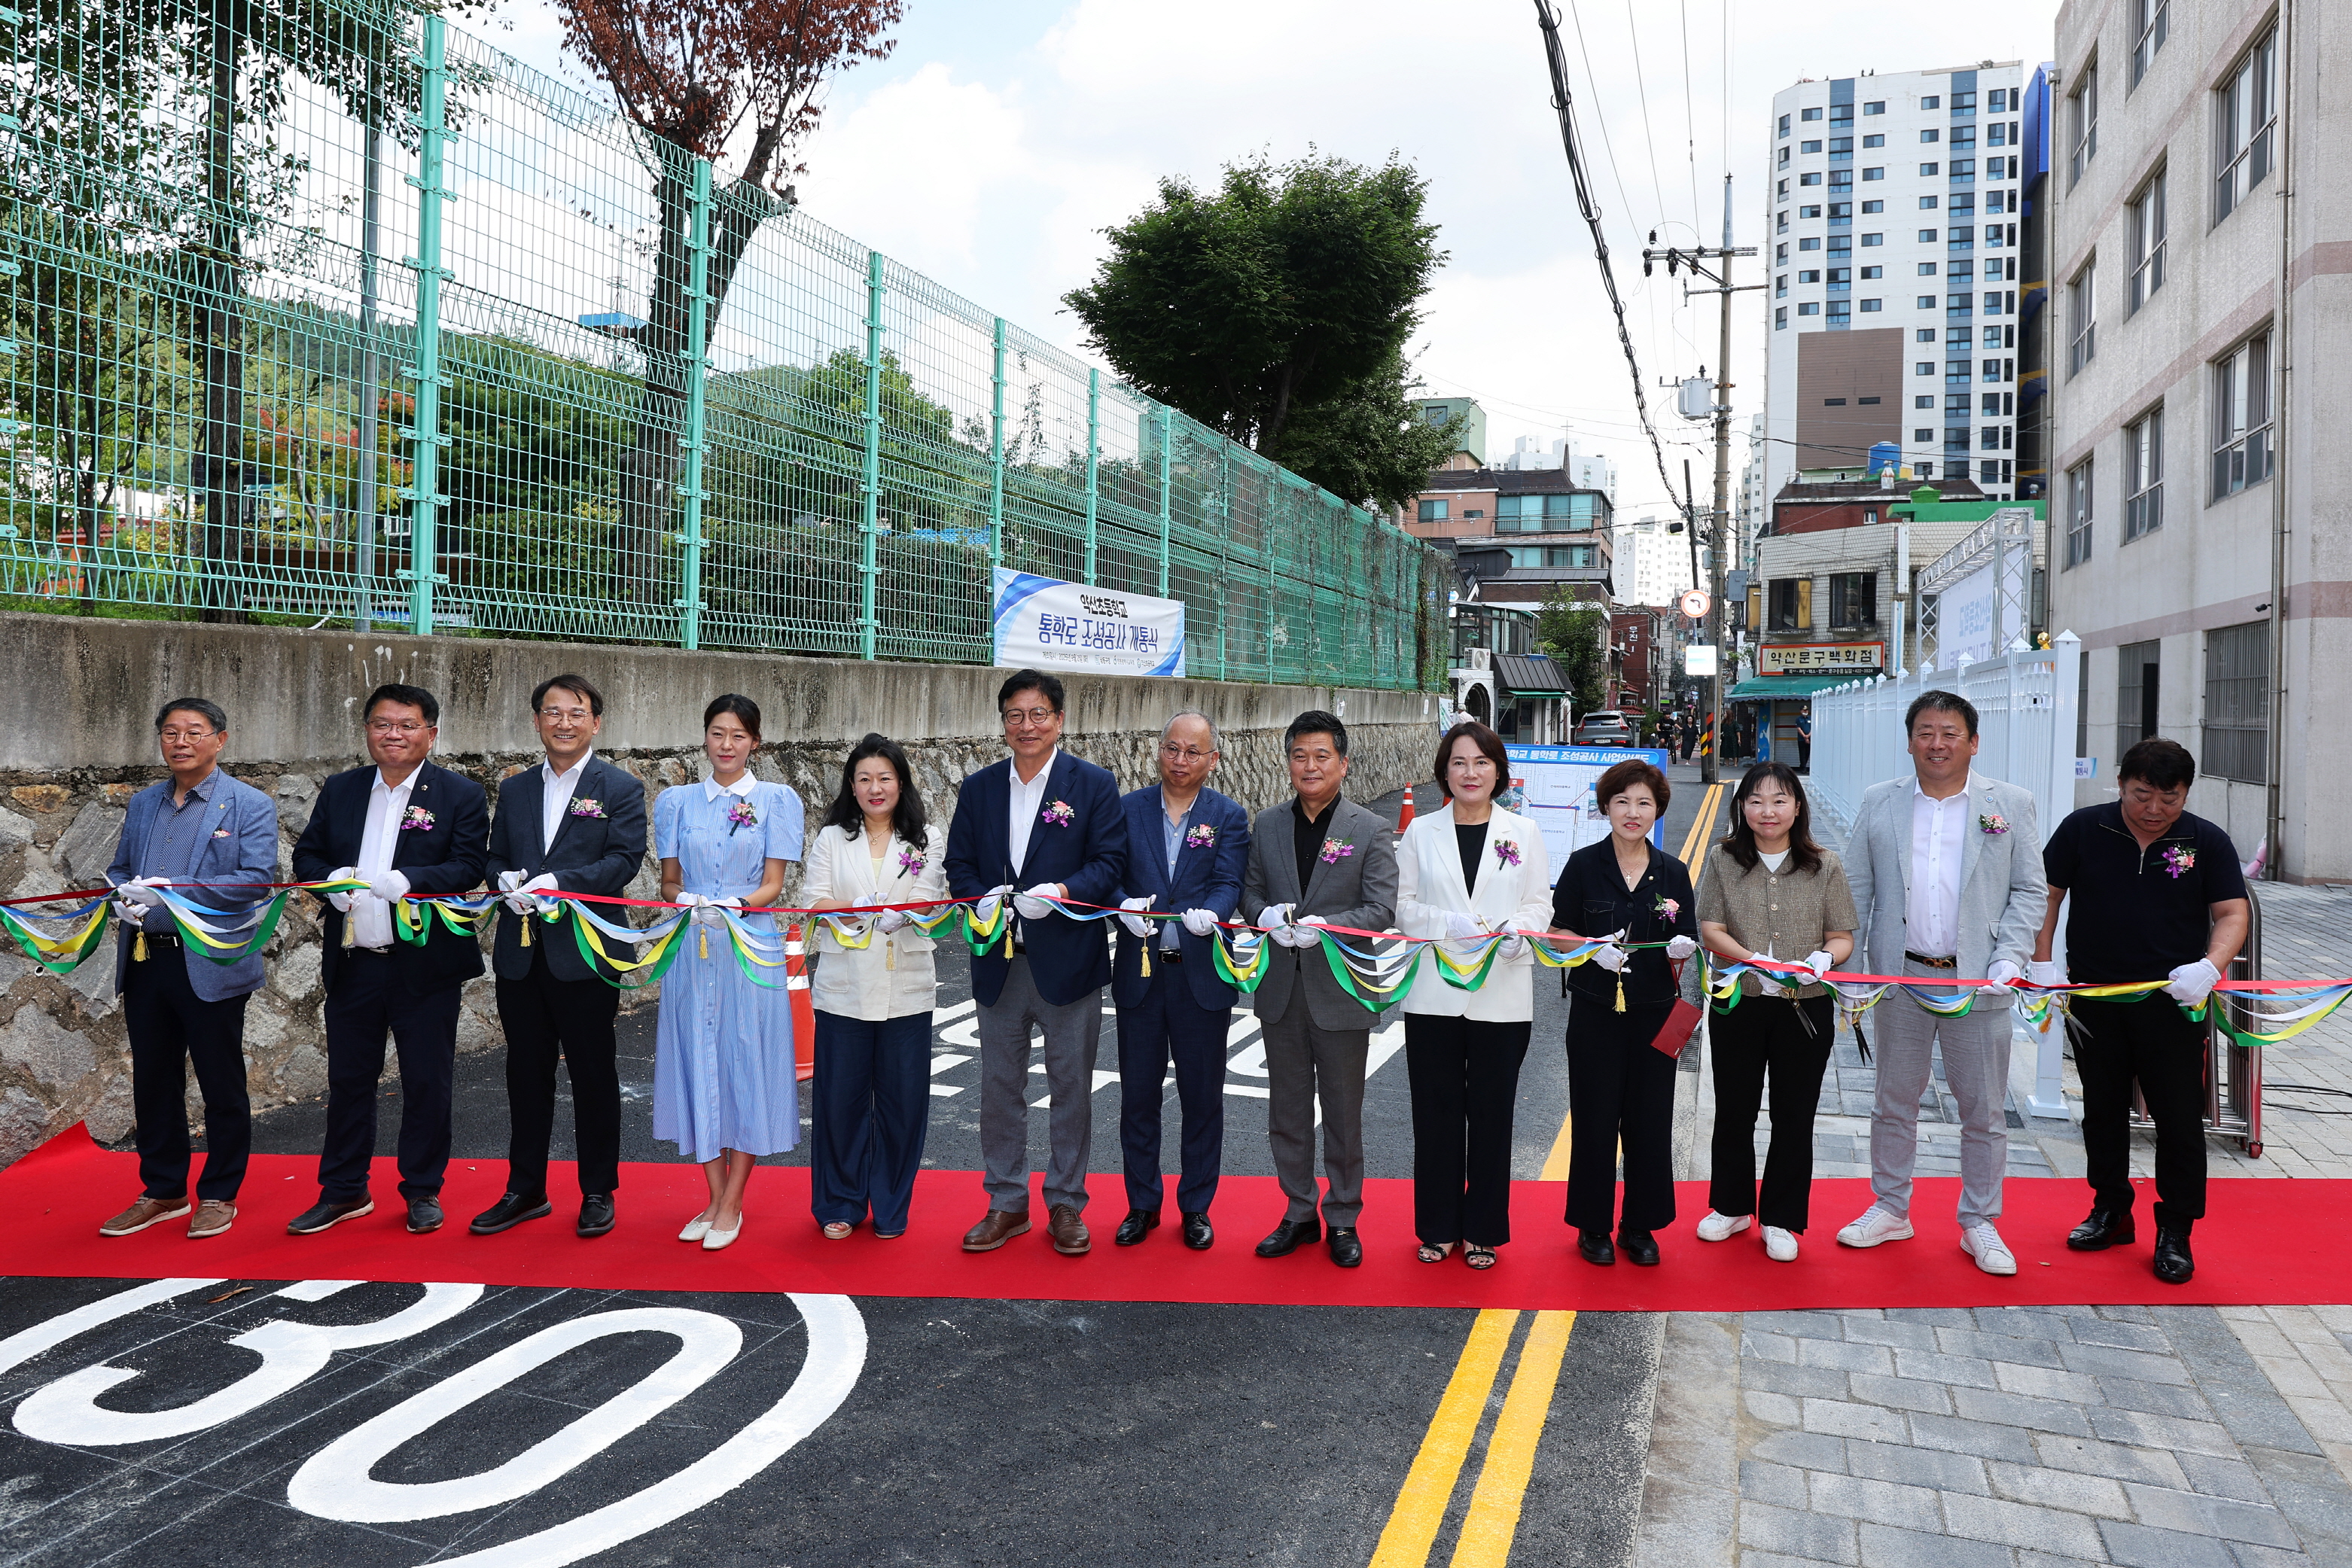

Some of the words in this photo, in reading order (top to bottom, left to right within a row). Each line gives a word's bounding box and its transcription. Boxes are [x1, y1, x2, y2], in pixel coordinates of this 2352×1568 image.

[1080, 594, 1128, 618] 약산초등학교
[1038, 613, 1077, 645] 통학로
[1081, 619, 1126, 650] 조성공사
[1129, 626, 1158, 653] 개통식
[1628, 626, 1638, 641] 우진
[1771, 650, 1872, 665] 약산문구백화점
[1530, 750, 1559, 760] 통학로
[1560, 751, 1599, 762] 조성공사
[12, 1279, 743, 1524] 30
